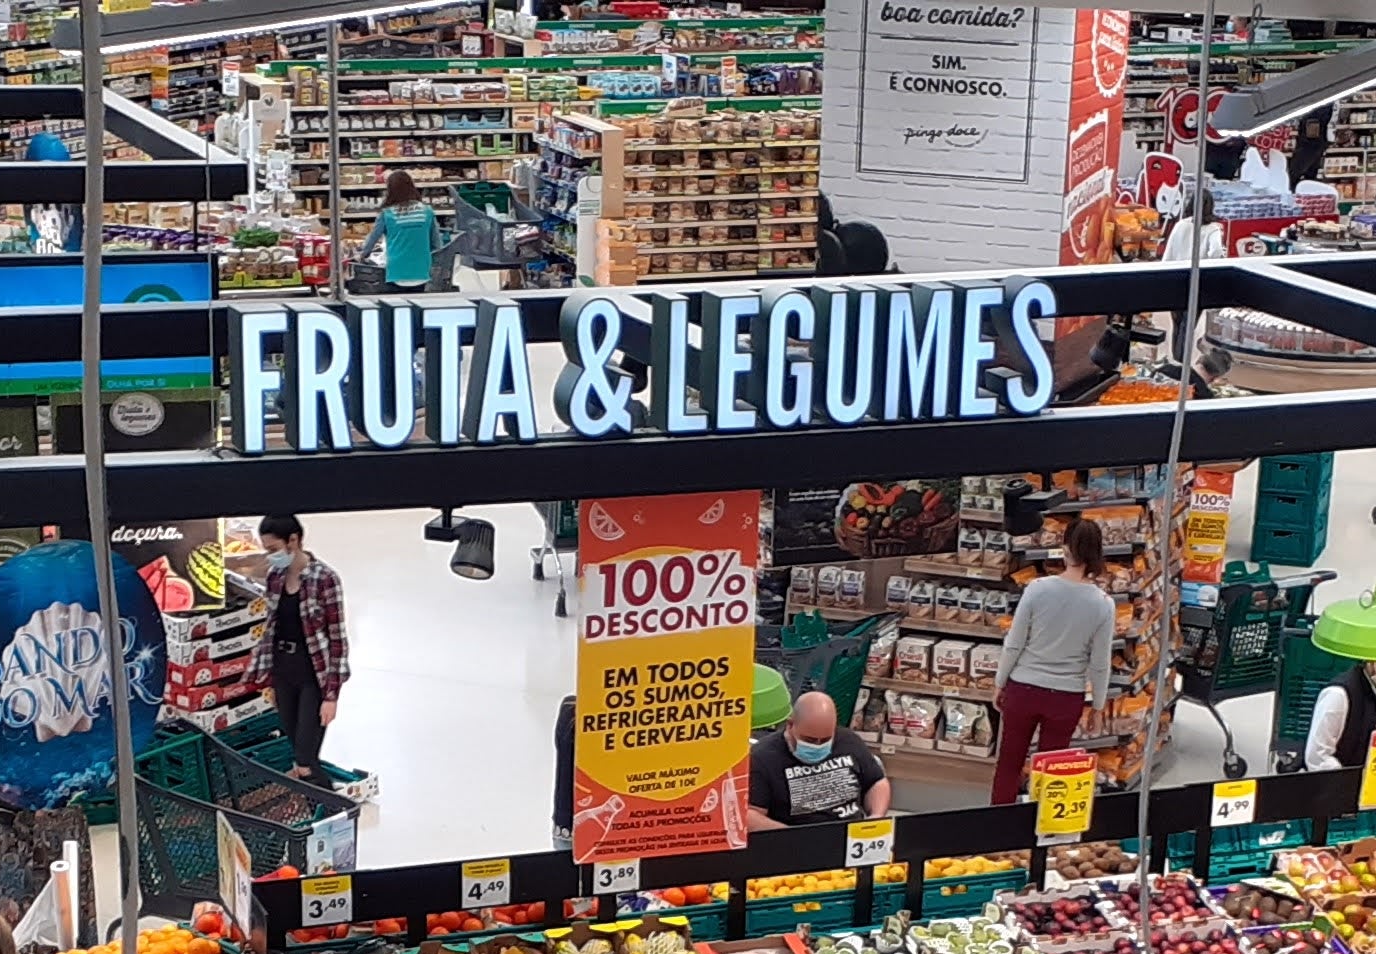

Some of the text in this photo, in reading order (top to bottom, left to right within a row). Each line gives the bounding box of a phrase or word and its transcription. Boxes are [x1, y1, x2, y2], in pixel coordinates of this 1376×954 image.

[880, 2, 1025, 28] boa comida?
[932, 55, 966, 71] SIM.
[890, 71, 1008, 98] É CONNOSCO.
[905, 123, 981, 145] pingo doce
[236, 281, 1057, 454] FRUTA & LEGUMES
[1195, 493, 1231, 507] 100%
[599, 552, 747, 608] 100%
[585, 600, 749, 640] DESCONTO
[604, 656, 731, 689] EM TODOS
[606, 680, 726, 709] OS SUMOS,
[582, 698, 747, 733] REFRIGERANTES
[604, 721, 723, 751] E CERVEJAS
[627, 771, 657, 783] VALOR
[785, 755, 855, 780] BROOKLYN
[1052, 801, 1087, 819] 2,39
[1217, 800, 1250, 819] 4,99
[851, 839, 885, 859] 3,49
[599, 866, 635, 888] 3,89
[468, 880, 505, 901] 4,49
[309, 897, 347, 919] 3,49
